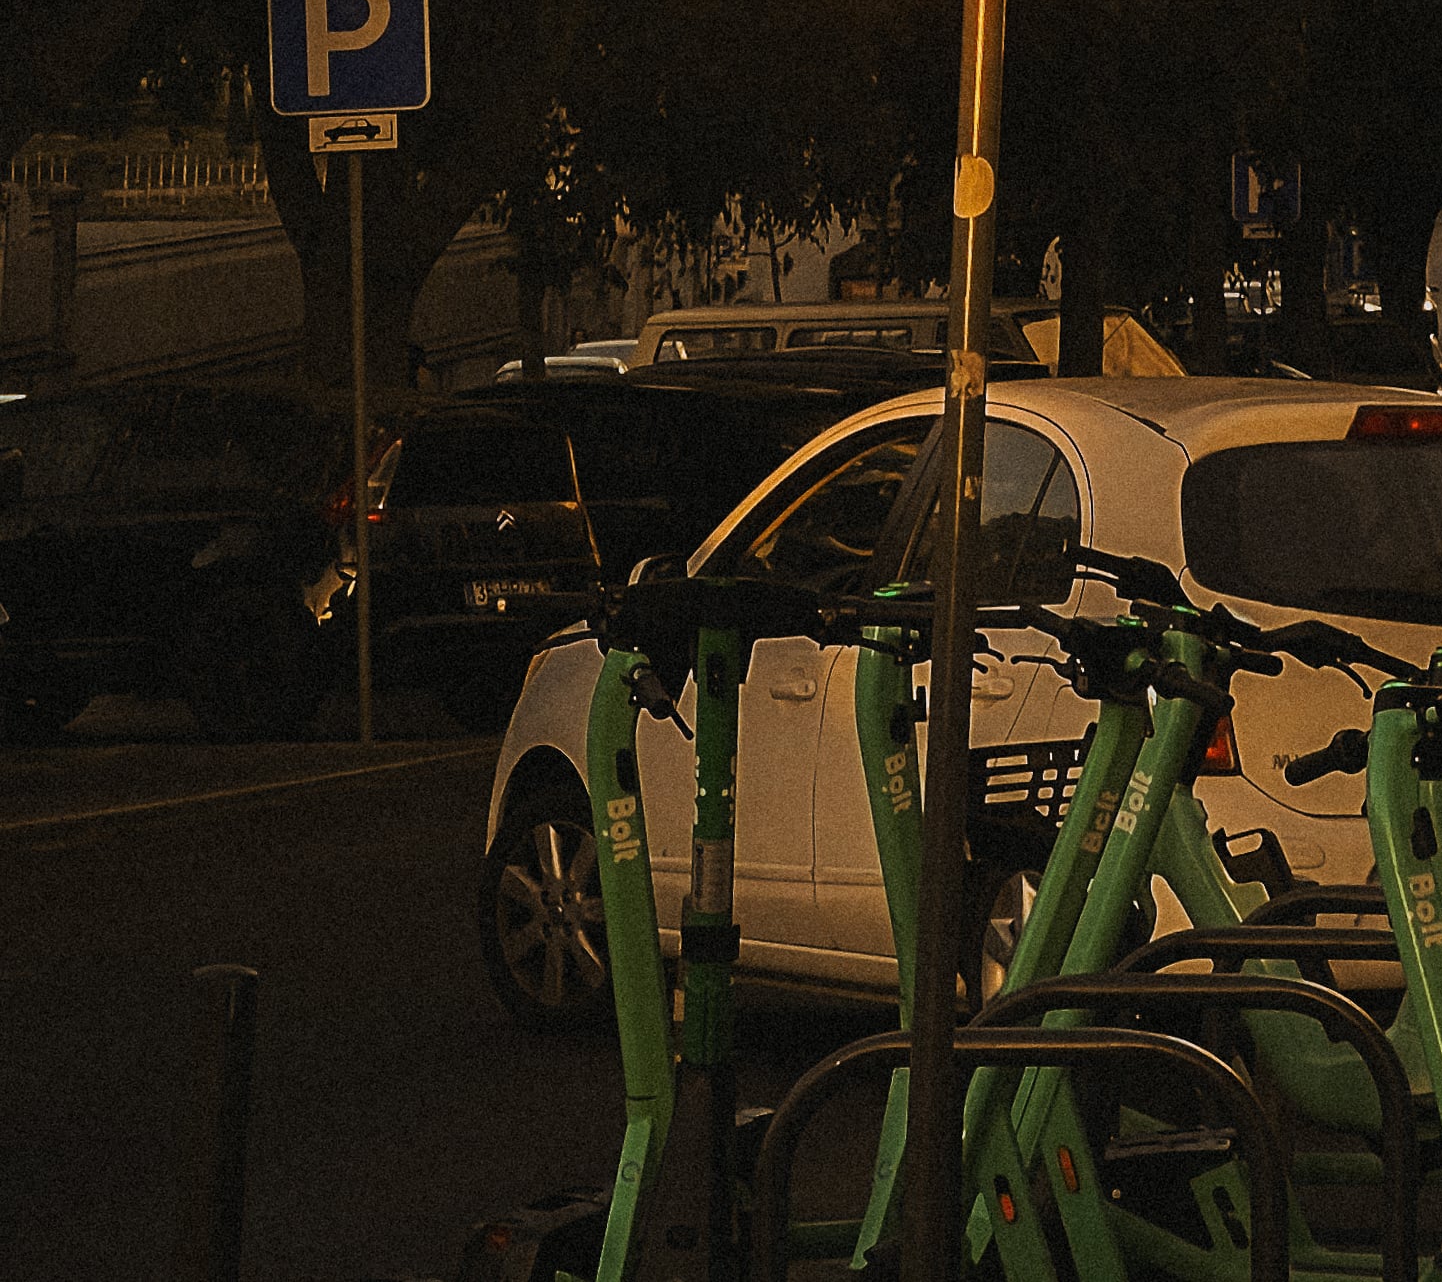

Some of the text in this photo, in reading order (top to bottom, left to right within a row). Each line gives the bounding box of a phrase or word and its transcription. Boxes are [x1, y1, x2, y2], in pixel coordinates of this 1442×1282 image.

[882, 751, 914, 815] Bolt
[1115, 770, 1154, 836] Bolt
[602, 795, 642, 866] Bolt
